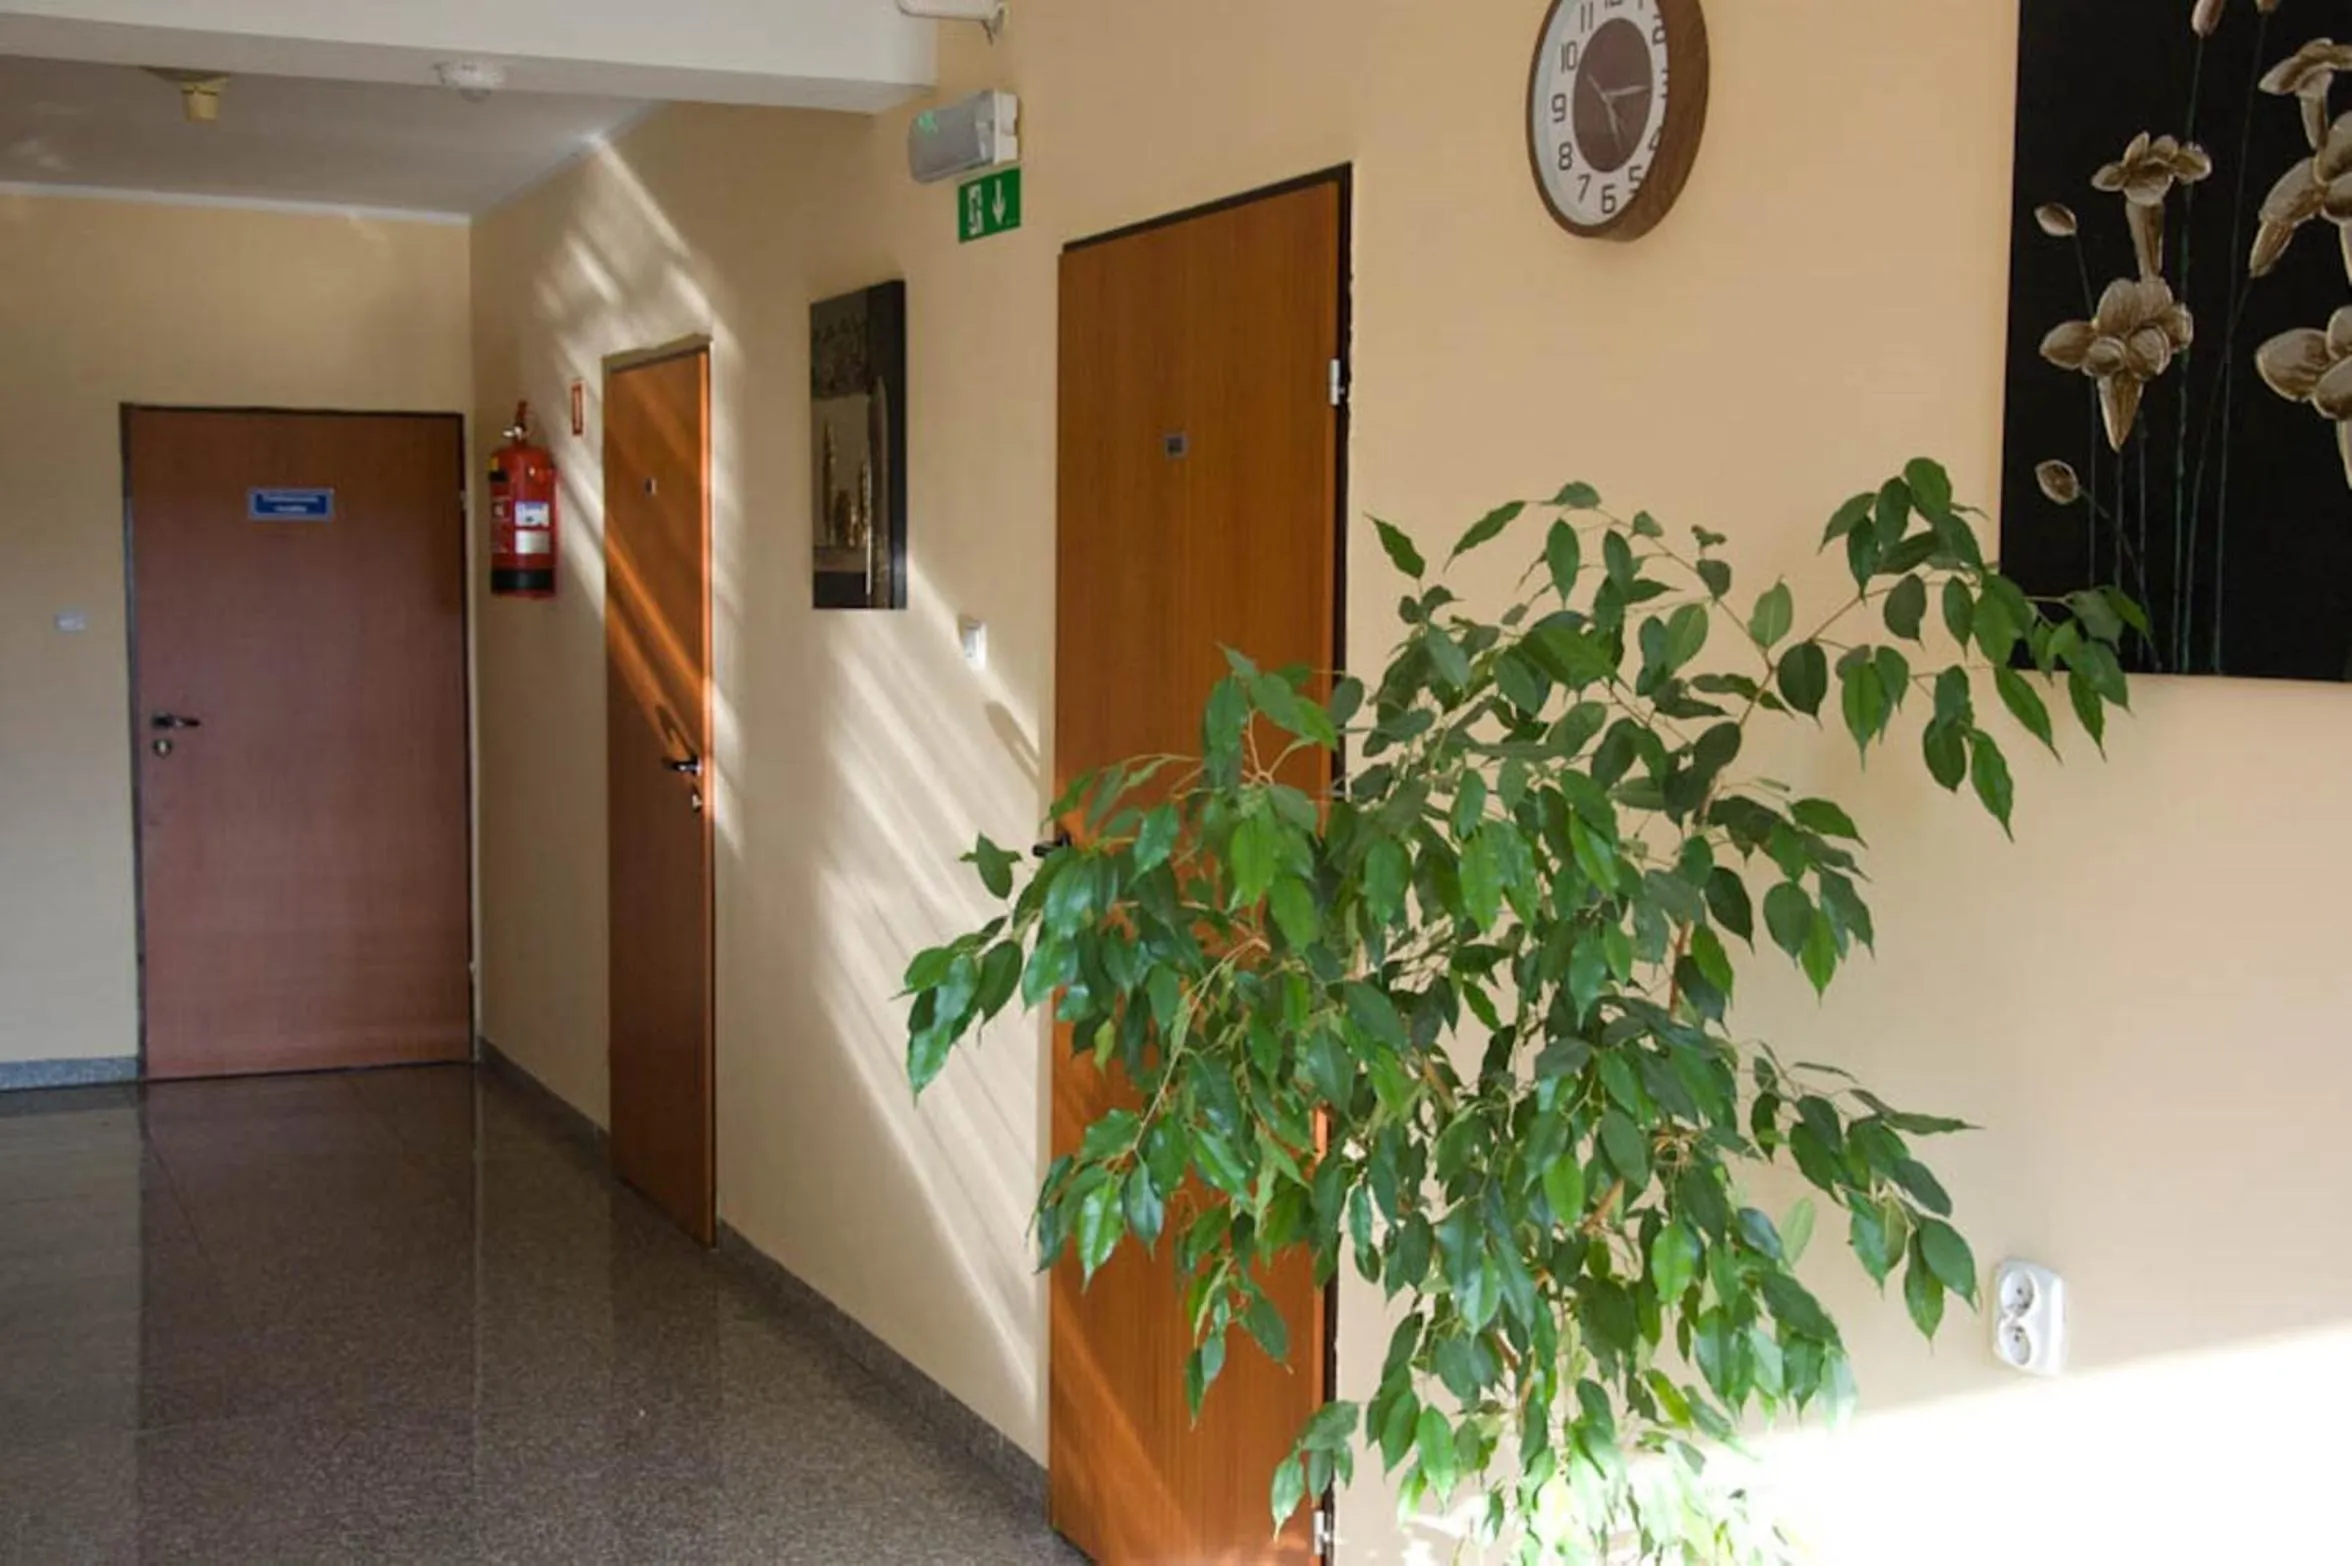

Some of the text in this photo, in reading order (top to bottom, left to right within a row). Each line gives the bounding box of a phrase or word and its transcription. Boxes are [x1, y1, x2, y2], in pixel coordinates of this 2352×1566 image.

[1580, 0, 1594, 33] 11
[1561, 41, 1577, 73] 10
[1551, 93, 1567, 123] 9
[1558, 142, 1573, 171] 8
[1577, 173, 1591, 204] 7
[1628, 165, 1643, 194] 5
[1601, 184, 1616, 214] 6
